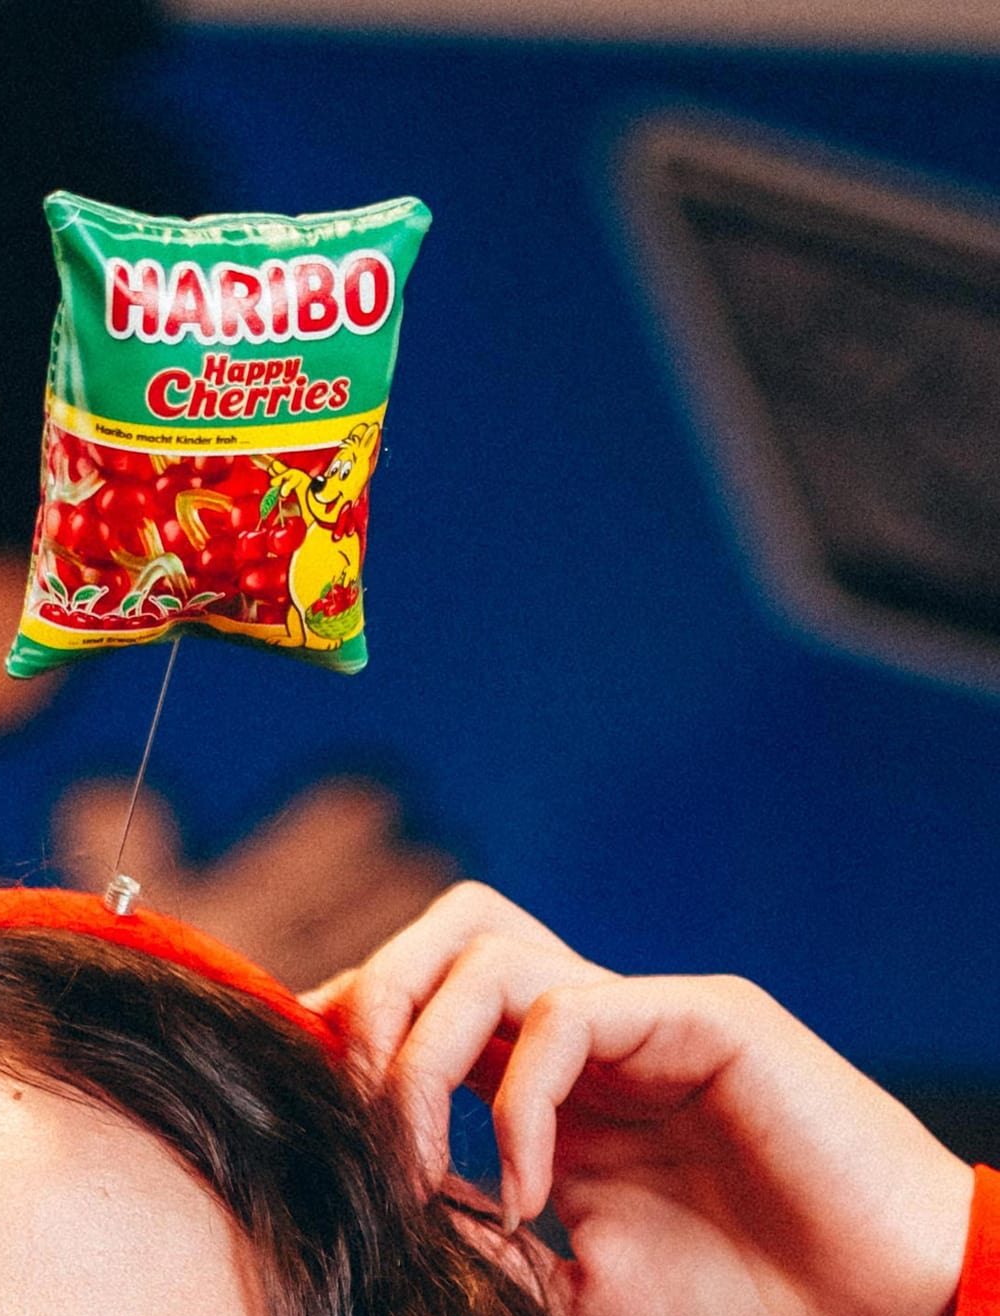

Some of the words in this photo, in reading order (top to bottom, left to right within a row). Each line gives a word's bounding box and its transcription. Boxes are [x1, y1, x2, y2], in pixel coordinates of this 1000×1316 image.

[109, 255, 391, 338] HARIBO
[203, 355, 302, 386] Happy
[147, 369, 350, 418] Cherries
[95, 423, 133, 440] Haribo
[136, 432, 173, 444] macht
[176, 434, 213, 445] Kinder
